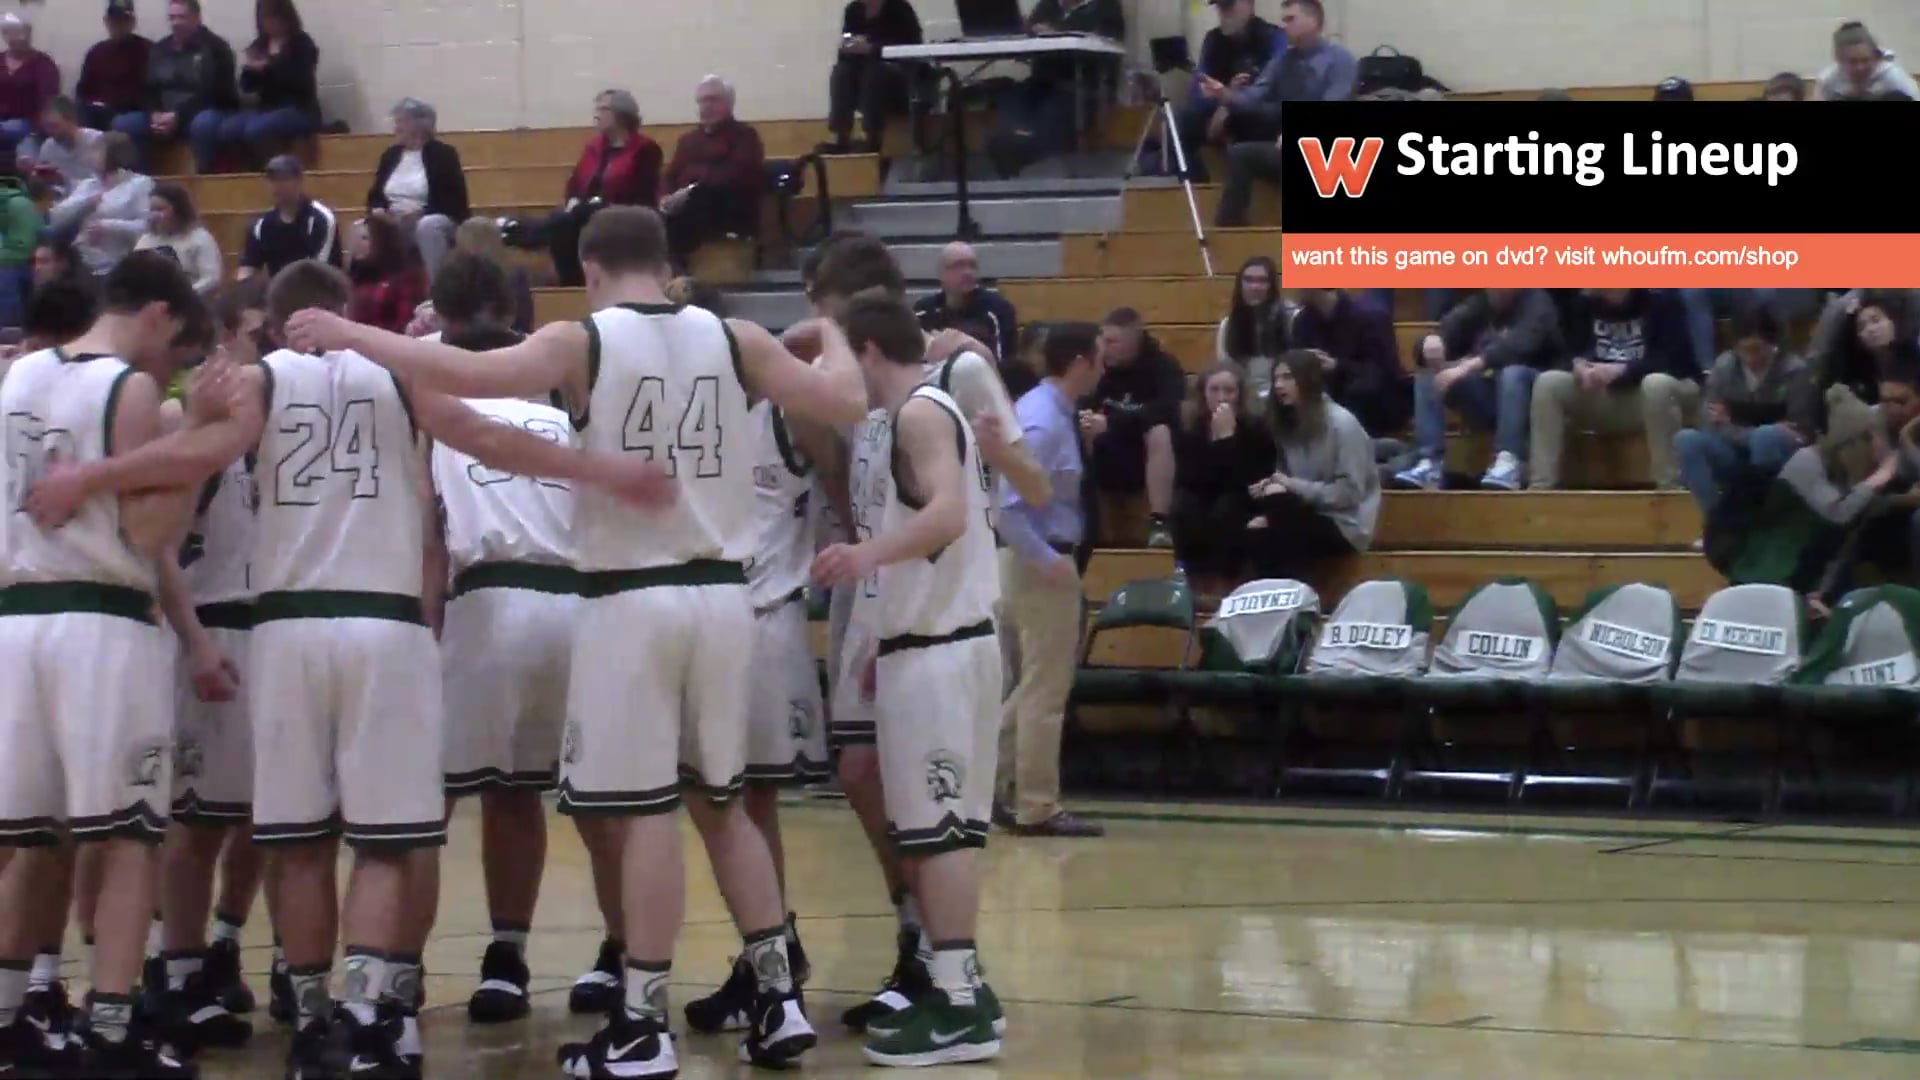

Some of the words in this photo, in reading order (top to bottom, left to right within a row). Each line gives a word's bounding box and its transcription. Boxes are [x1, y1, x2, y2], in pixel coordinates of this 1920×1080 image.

[275, 398, 379, 506] 24
[622, 376, 722, 478] 44
[1348, 625, 1406, 646] DULEY
[1469, 633, 1532, 658] COLLIN
